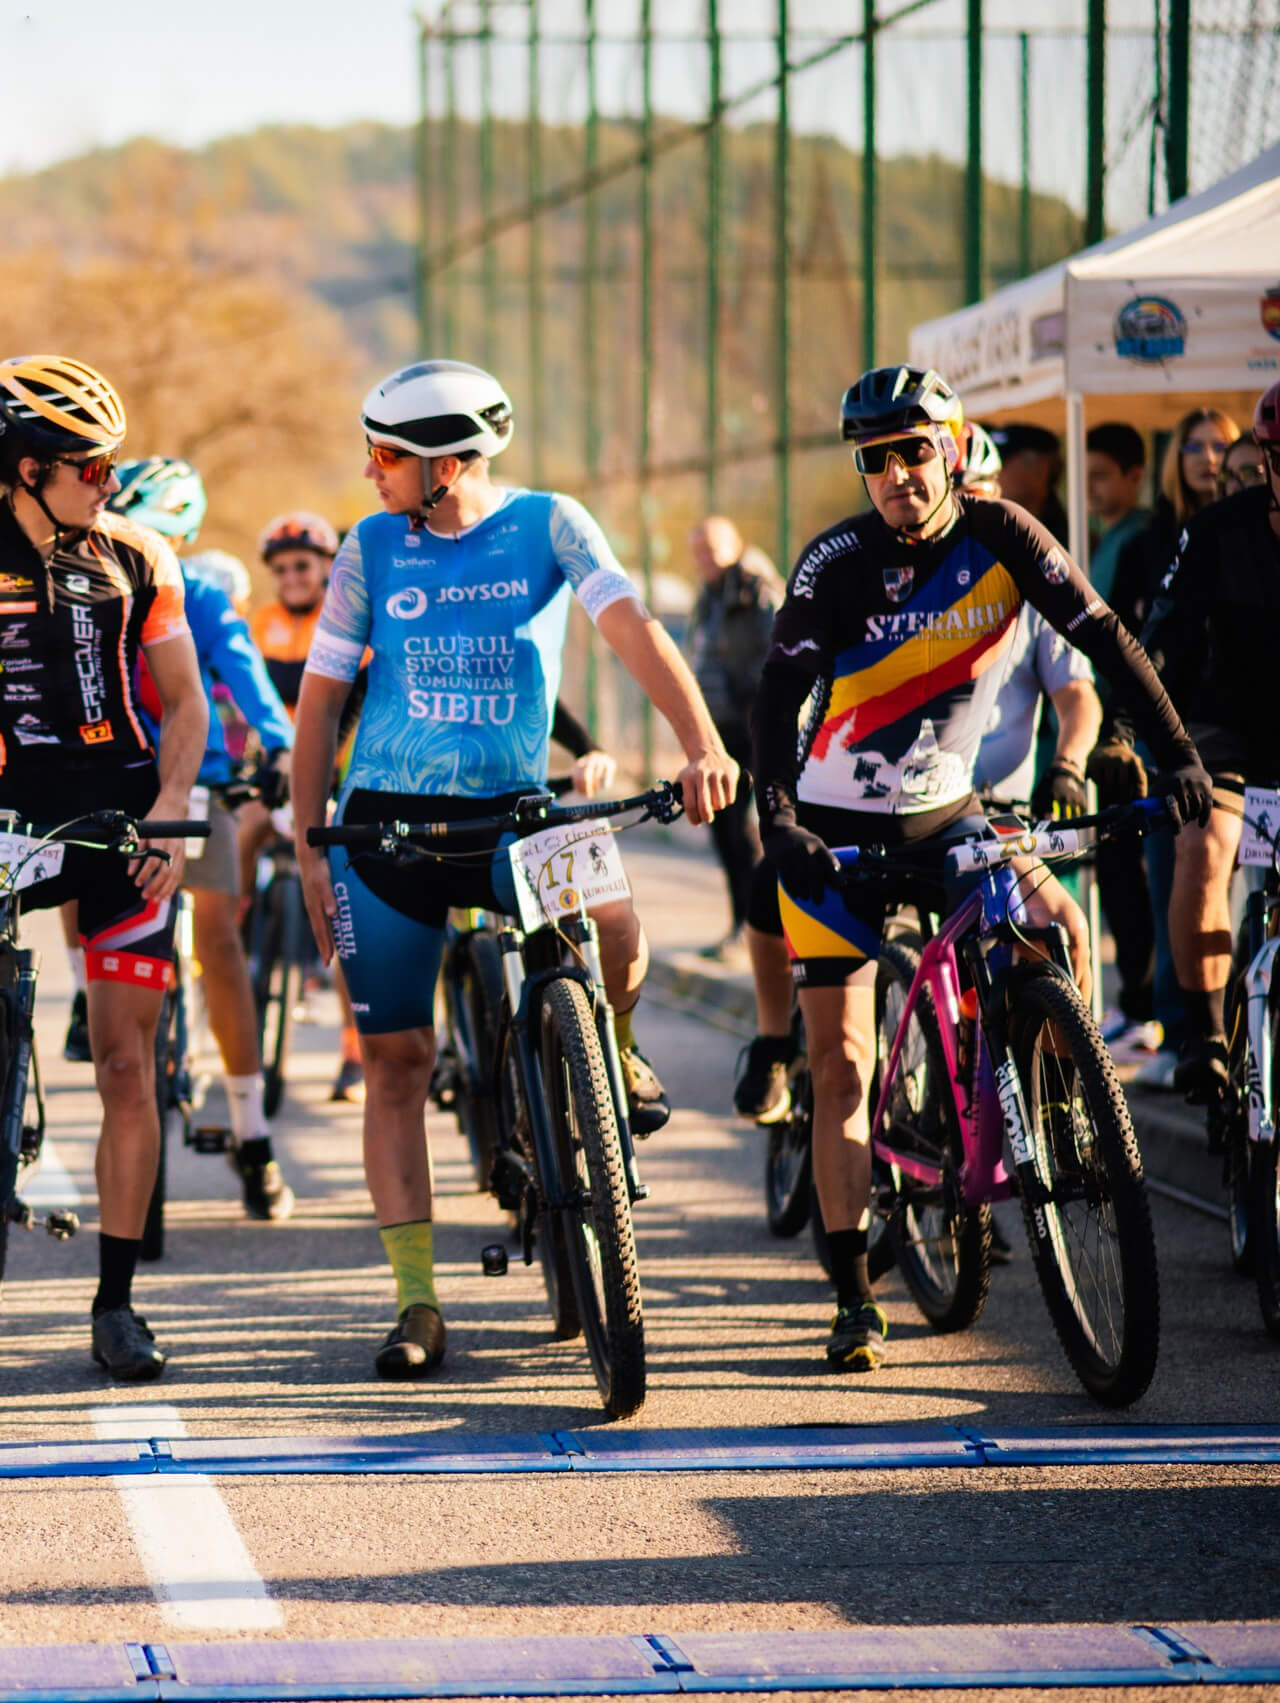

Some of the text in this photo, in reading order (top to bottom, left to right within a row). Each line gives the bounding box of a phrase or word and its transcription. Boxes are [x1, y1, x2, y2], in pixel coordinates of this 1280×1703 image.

[435, 579, 529, 603] JOYSON
[403, 636, 516, 655] CLUBUL
[405, 656, 515, 675] SPORTIV
[407, 674, 515, 690] COMUNITAR
[407, 689, 519, 726] SIBIU
[542, 851, 576, 890] 17
[334, 882, 357, 956] CLUBUL
